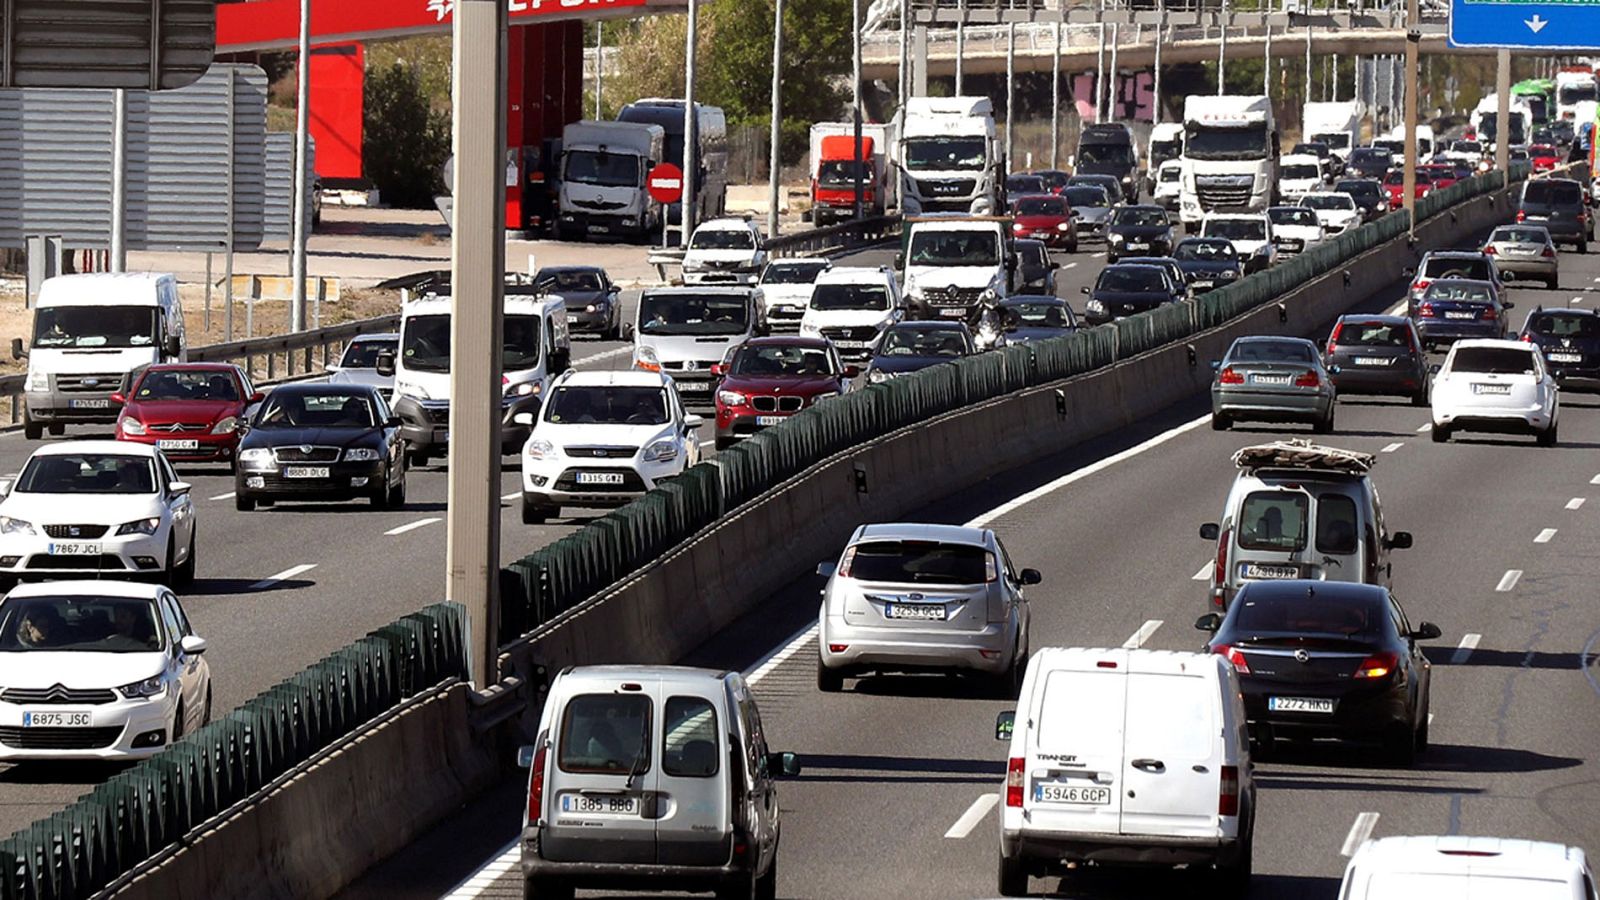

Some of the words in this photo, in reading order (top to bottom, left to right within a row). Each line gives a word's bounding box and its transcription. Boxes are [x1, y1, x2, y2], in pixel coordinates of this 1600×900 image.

[55, 544, 80, 553] 7867
[82, 544, 100, 554] JCL
[1277, 697, 1304, 709] 2272
[32, 714, 63, 725] 6875
[67, 714, 89, 725] JSC
[1044, 788, 1078, 801] 5946
[1081, 789, 1106, 802] GCP
[574, 798, 603, 811] 1385
